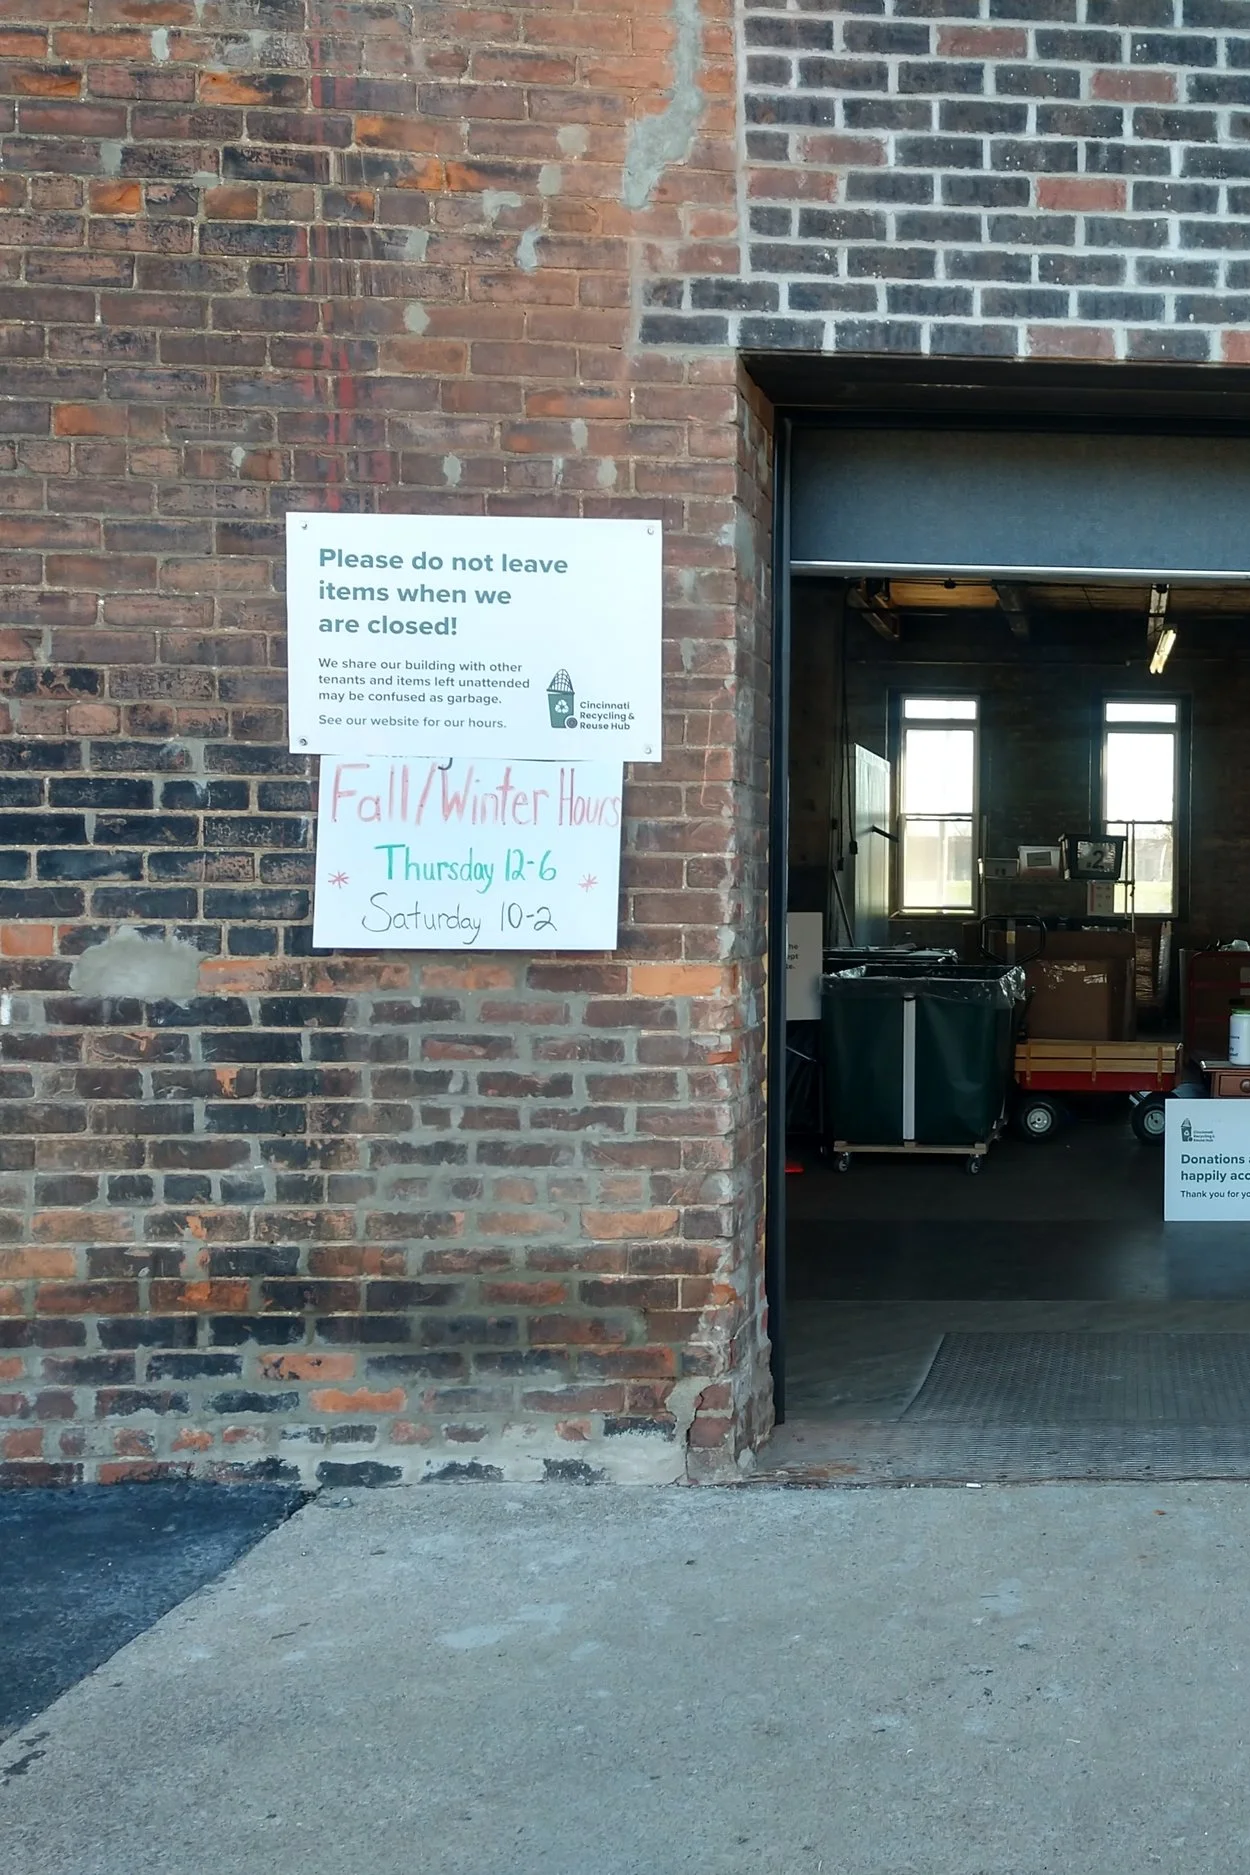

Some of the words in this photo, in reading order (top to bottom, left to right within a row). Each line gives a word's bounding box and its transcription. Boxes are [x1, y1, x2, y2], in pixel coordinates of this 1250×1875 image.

[320, 548, 403, 569] Please
[412, 552, 443, 570] do
[453, 555, 493, 571] not
[502, 554, 568, 573] leave
[320, 580, 389, 601] items
[397, 584, 466, 603] when
[475, 590, 511, 604] we
[319, 619, 359, 633] are
[368, 616, 456, 635] closed!
[319, 658, 338, 668] We
[342, 659, 376, 669] share
[406, 660, 455, 673] building
[459, 661, 485, 671] with
[490, 663, 522, 672] other
[319, 675, 365, 684] tenants
[370, 676, 392, 685] and
[397, 676, 430, 686] items
[435, 677, 454, 686] left
[459, 679, 529, 688] unattended
[319, 693, 345, 702] may
[349, 691, 364, 700] be
[368, 692, 425, 702] confused
[447, 694, 501, 705] garbage.
[580, 701, 629, 709] Cincinnati
[319, 715, 342, 724] See
[371, 716, 419, 726] website
[423, 717, 440, 726] for
[469, 718, 506, 728] hours.
[580, 712, 626, 722] Recycling
[331, 762, 549, 826] Fall/Winter
[558, 767, 621, 827] Hours
[374, 844, 493, 894] Thursday
[505, 848, 557, 881] 12-6
[362, 892, 481, 945] Saturday
[501, 901, 557, 932] 10-2
[1181, 1154, 1245, 1164] Donations
[1181, 1170, 1227, 1182] happily
[1209, 1191, 1224, 1199] you
